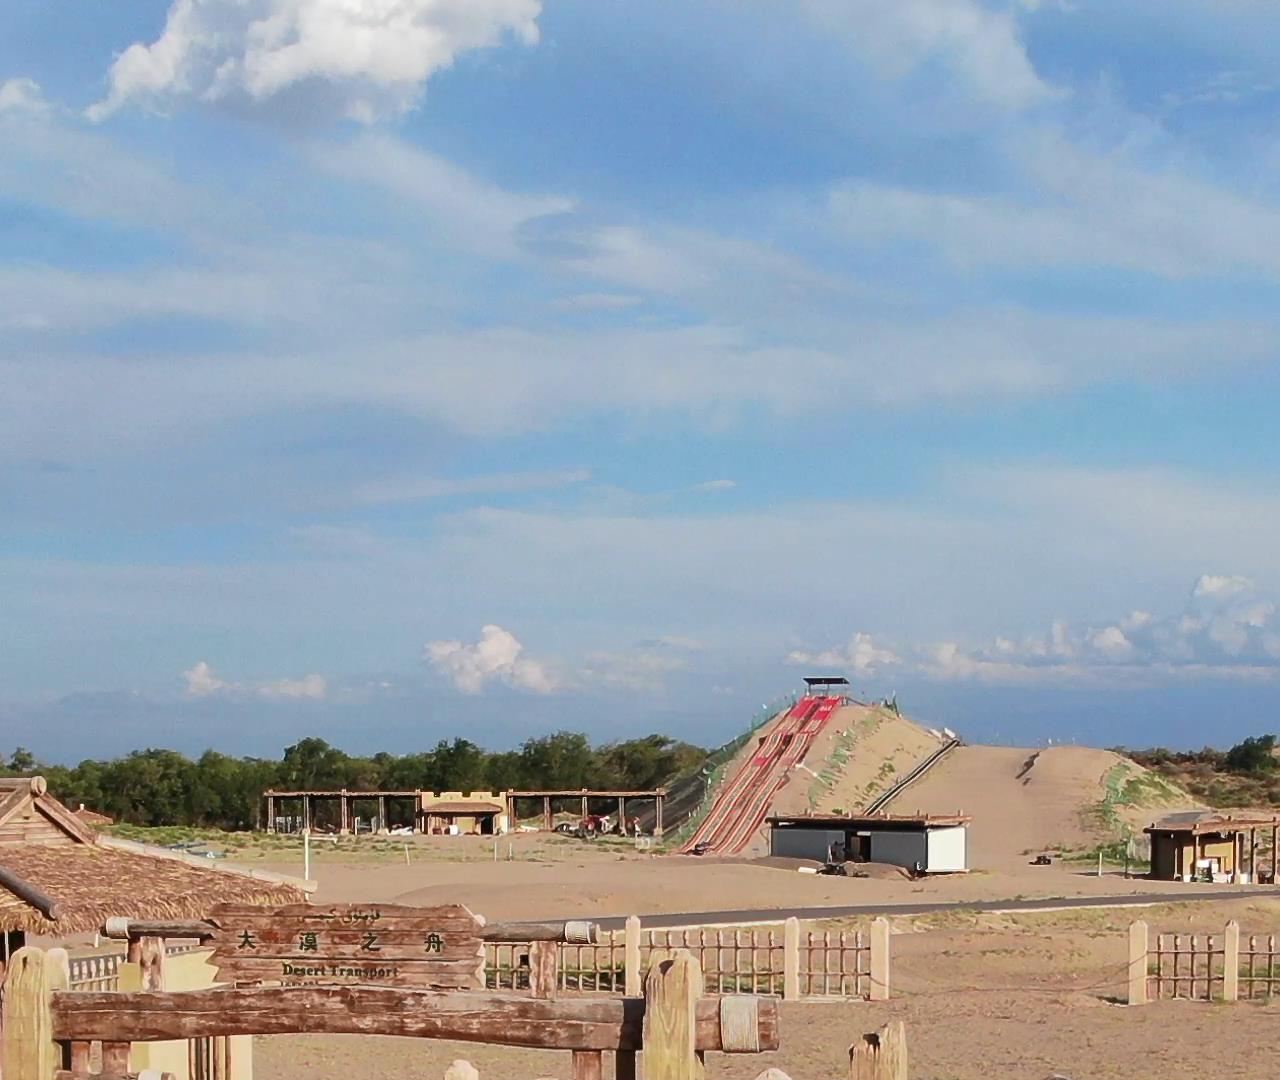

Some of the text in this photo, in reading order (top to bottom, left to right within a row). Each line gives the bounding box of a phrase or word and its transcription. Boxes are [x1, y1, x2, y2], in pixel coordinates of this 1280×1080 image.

[237, 929, 444, 953] 大漠之舟
[282, 961, 399, 978] Desert Transport
